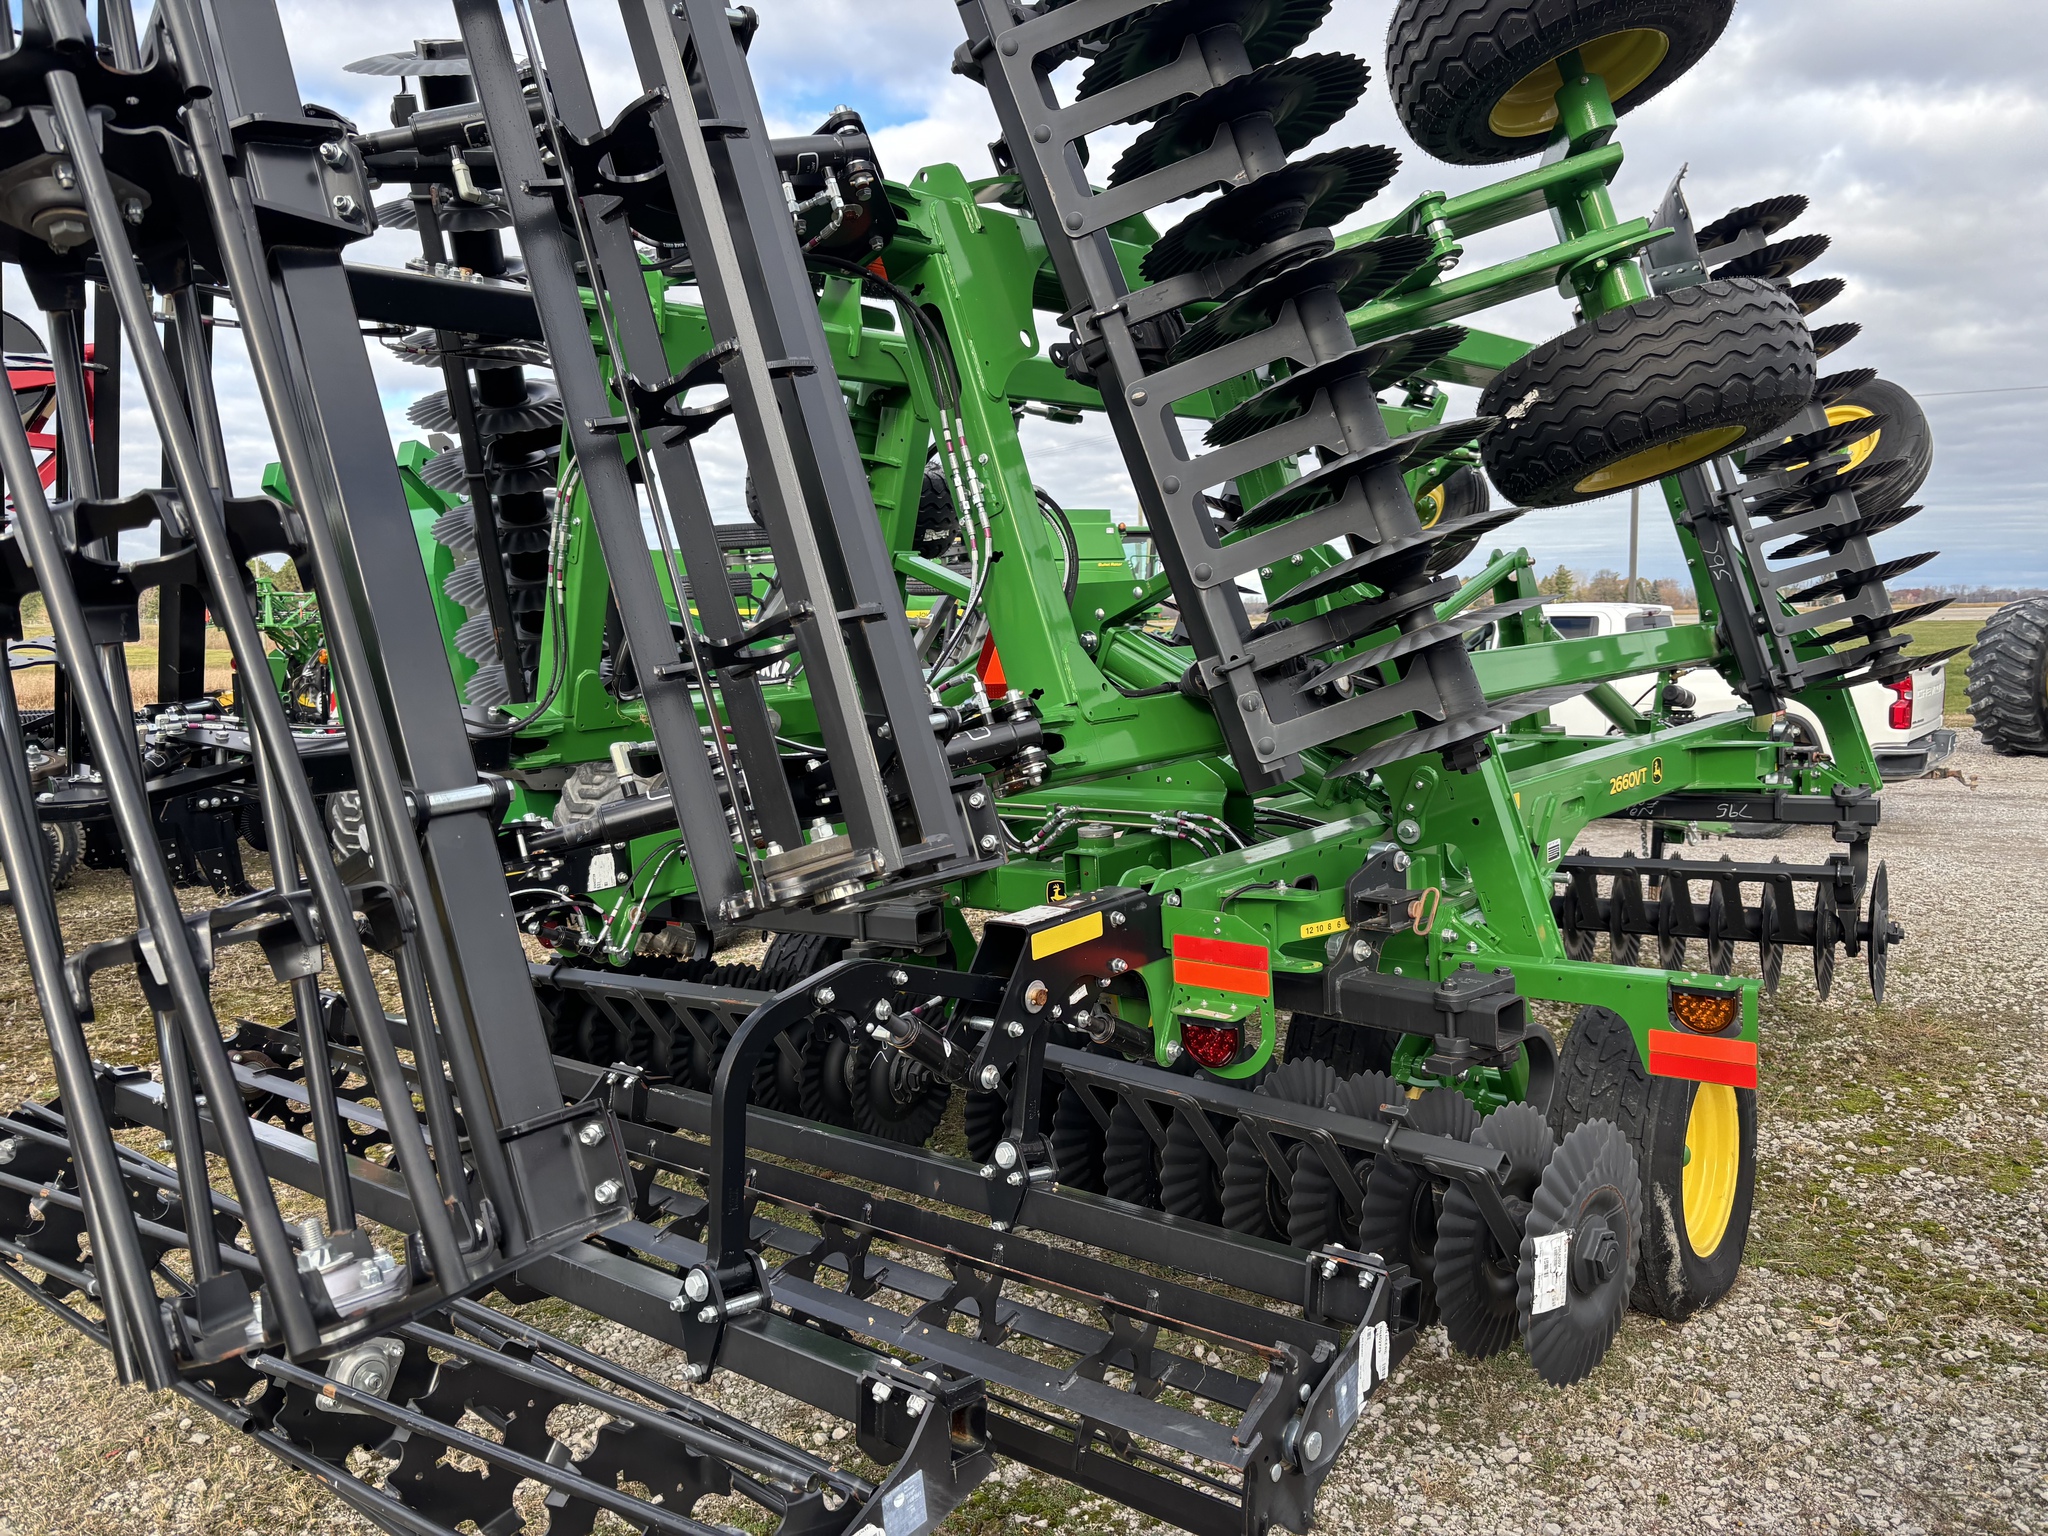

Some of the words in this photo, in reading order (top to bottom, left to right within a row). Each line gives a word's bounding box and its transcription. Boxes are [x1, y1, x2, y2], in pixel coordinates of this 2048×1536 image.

[1702, 540, 1733, 582] 795
[1609, 767, 1648, 795] 2660VT
[1715, 803, 1753, 819] 795
[1305, 927, 1314, 935] 12
[1316, 925, 1324, 933] 10
[1327, 923, 1332, 931] 8
